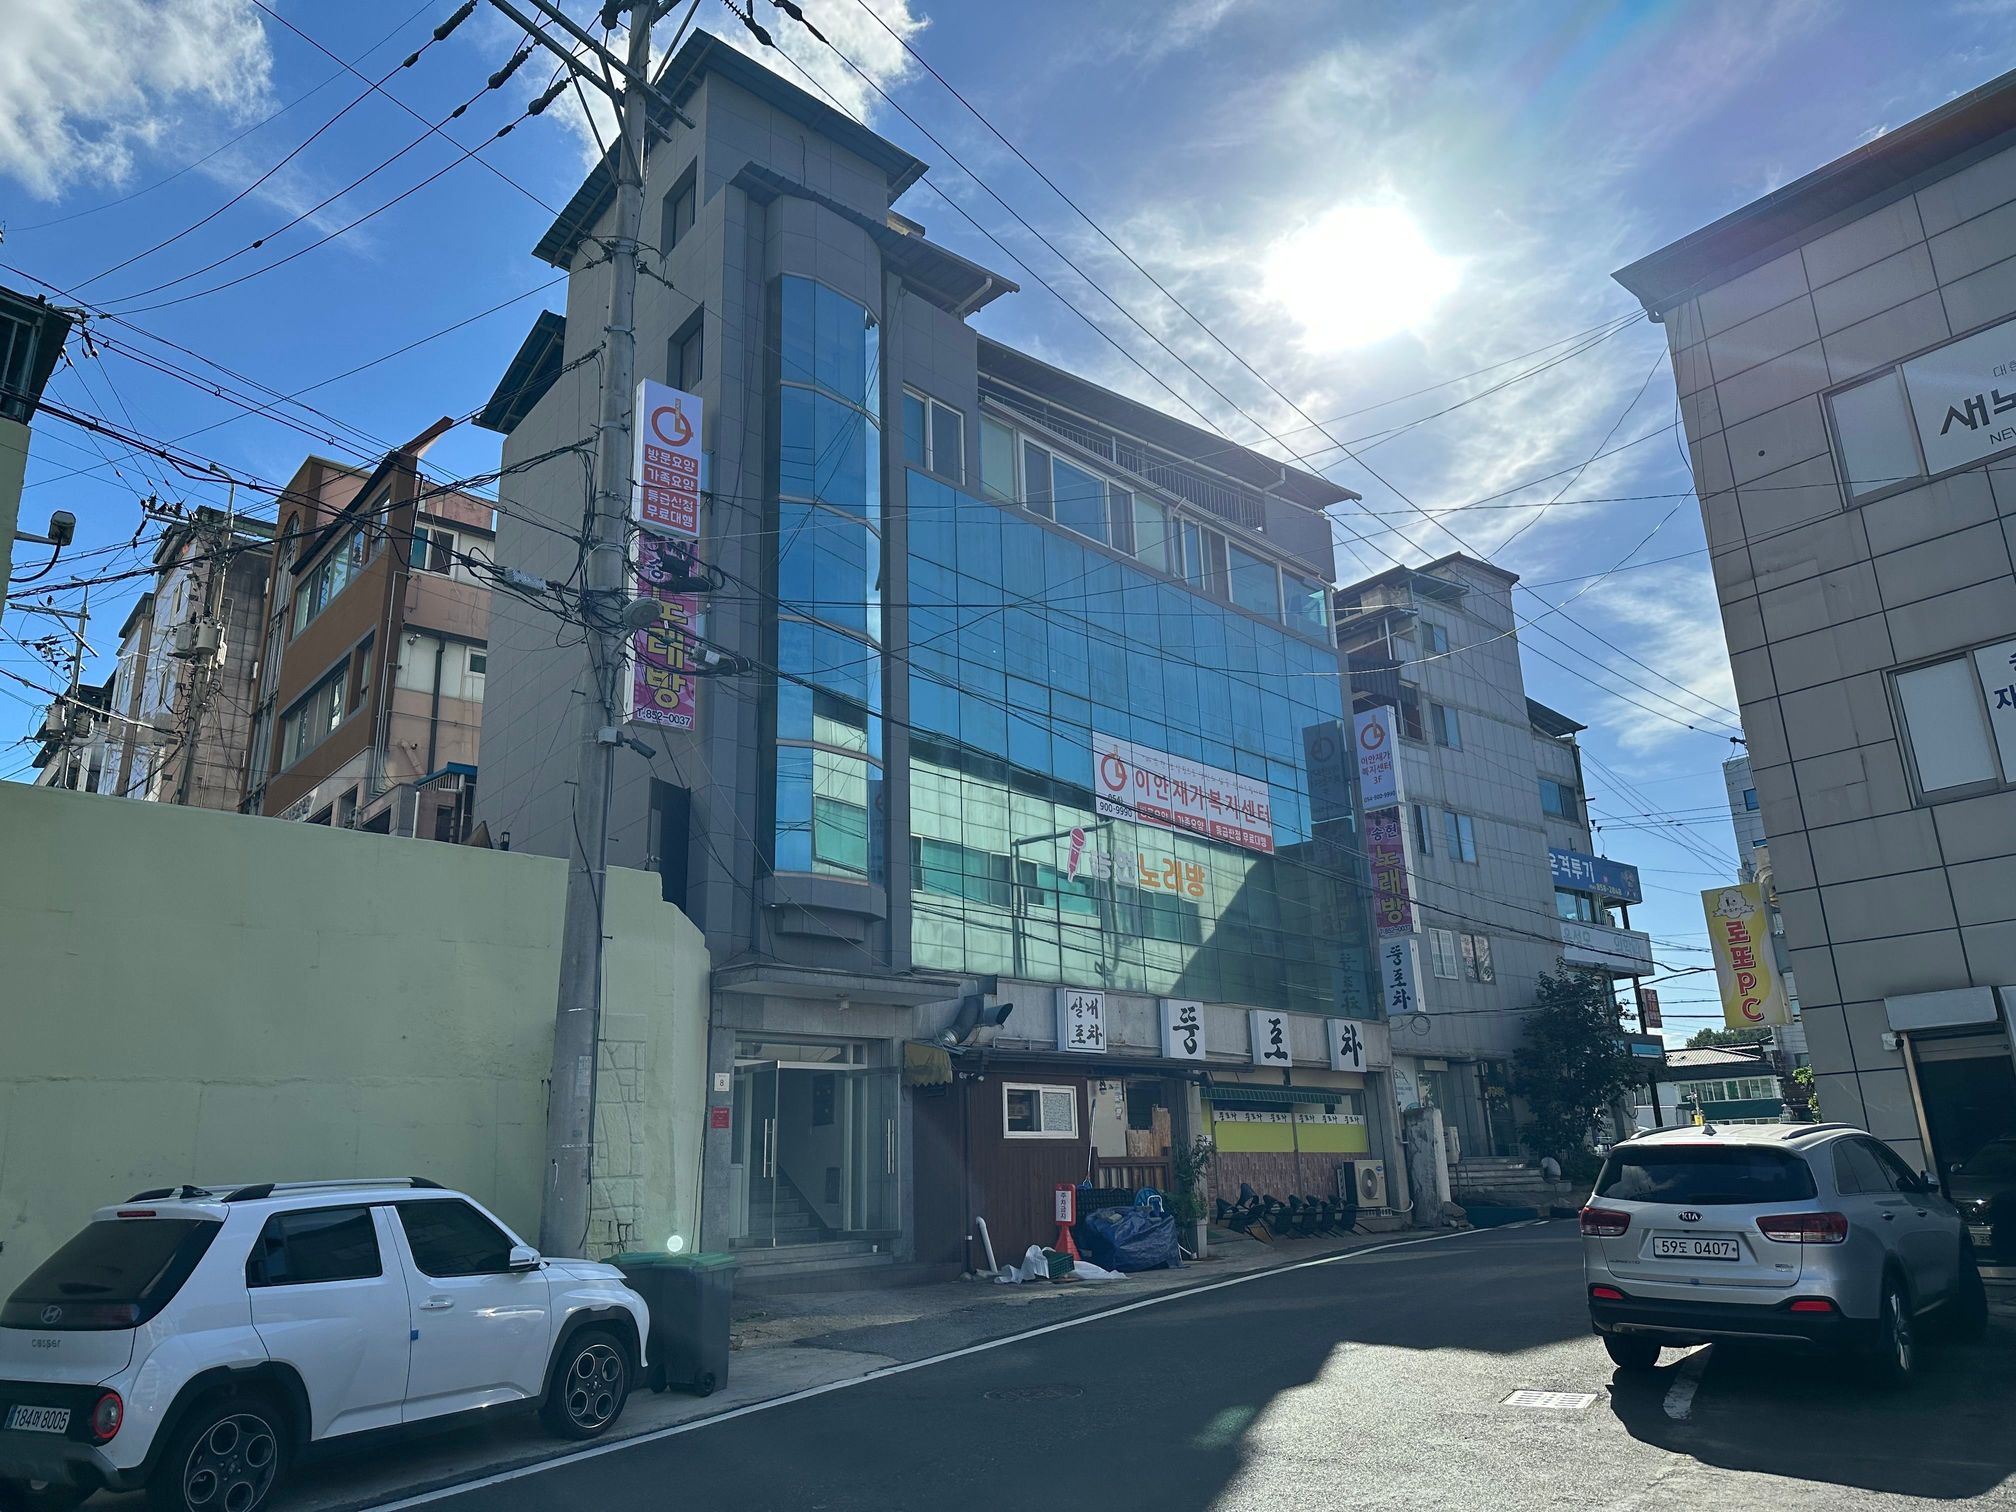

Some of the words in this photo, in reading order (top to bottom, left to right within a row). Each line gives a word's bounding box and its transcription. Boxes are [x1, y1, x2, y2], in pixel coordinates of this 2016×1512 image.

[647, 446, 696, 473] 방문요양
[647, 466, 695, 492] 가족요양
[646, 503, 694, 528] 무료대행
[636, 706, 691, 727] T.852-0037
[1099, 801, 1133, 818] 900-9990
[1375, 844, 1405, 924] 노래방
[719, 1079, 725, 1087] 8
[1681, 1211, 1700, 1222] KIA
[1661, 1240, 1687, 1254] 59도
[1693, 1241, 1730, 1256] 0407
[40, 1410, 69, 1431] 8005
